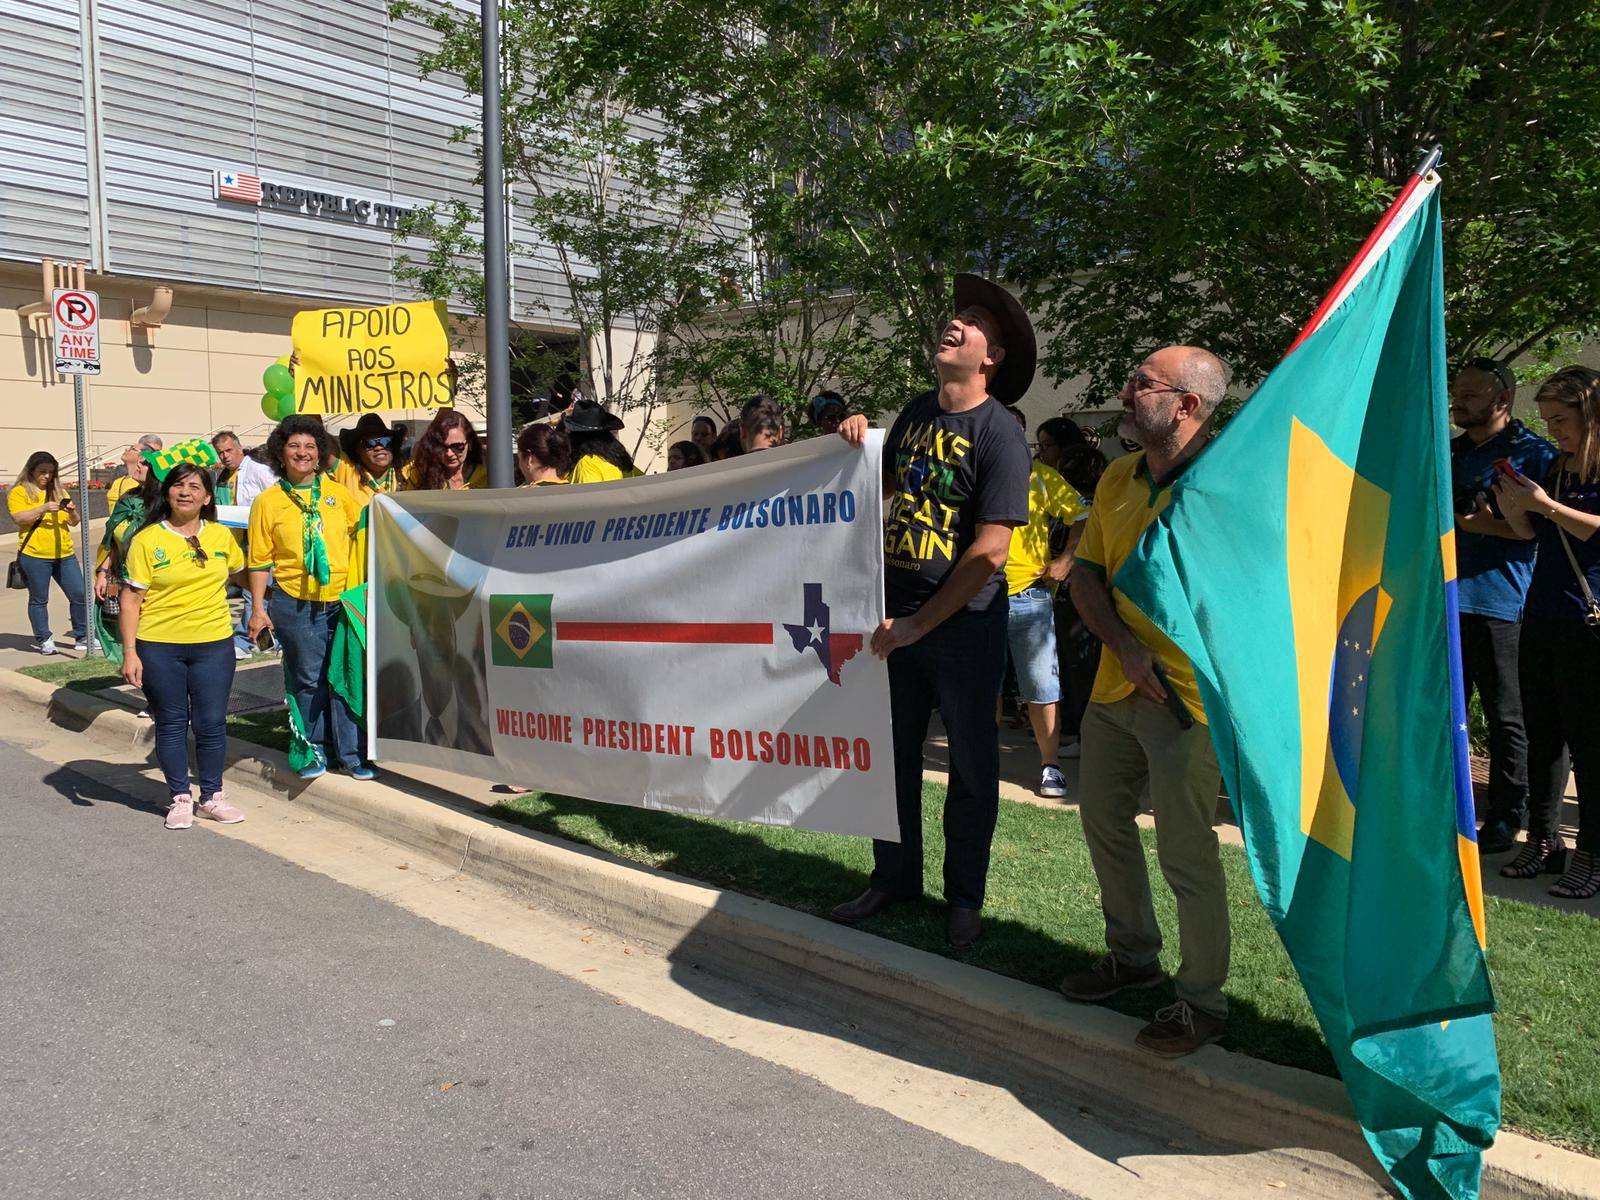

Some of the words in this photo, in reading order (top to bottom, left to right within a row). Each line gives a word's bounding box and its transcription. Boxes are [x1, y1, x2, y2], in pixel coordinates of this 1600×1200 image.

[261, 182, 371, 220] REPUBLIC
[61, 334, 93, 346] ANY
[322, 306, 411, 339] APOIO
[59, 346, 96, 359] TIME
[347, 346, 395, 371] AOS
[298, 371, 452, 413] MINISTROS
[900, 421, 973, 466] MAKE
[505, 520, 596, 548] BEM-VINDO
[601, 507, 711, 543] PRESIDENTE
[717, 489, 855, 532] BOLSONARO
[885, 524, 954, 560] GAIN
[496, 708, 572, 744] WELCOME
[583, 717, 695, 757] PRESIDENT
[709, 728, 871, 773] BOLSONARO
